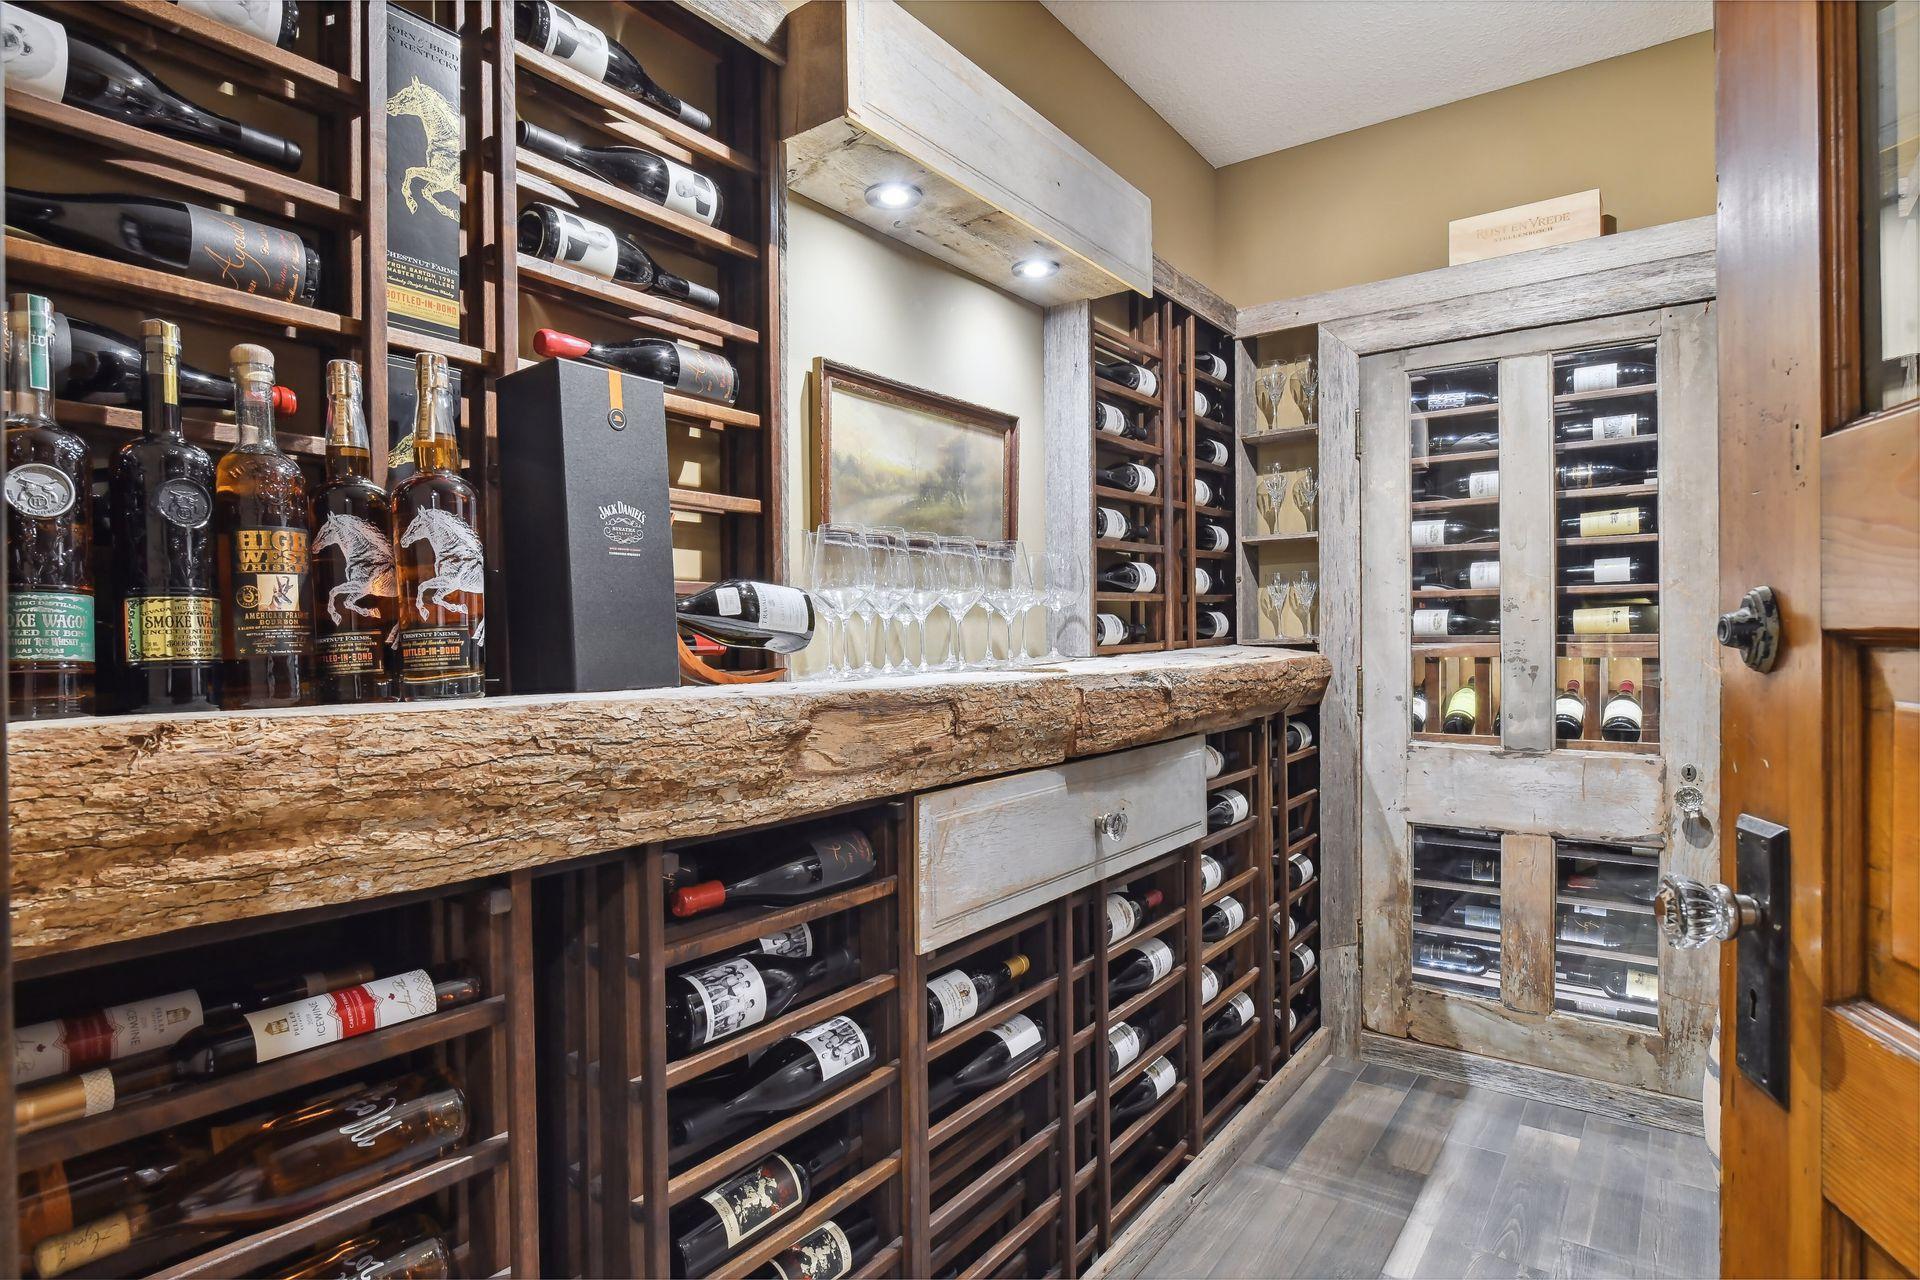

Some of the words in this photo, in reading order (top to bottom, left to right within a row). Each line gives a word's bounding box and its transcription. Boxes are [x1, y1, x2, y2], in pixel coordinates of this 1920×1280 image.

[400, 40, 459, 72] KENTUCKY
[1476, 225, 1507, 240] RUST
[1511, 222, 1527, 232] EN
[387, 249, 430, 268] CHESTNUT
[387, 261, 407, 270] FROM
[410, 267, 436, 279] BARTON
[439, 275, 455, 284] 1792
[387, 266, 415, 278] MASTER
[416, 274, 455, 290] DISTILLERS
[598, 503, 618, 520] JACK
[617, 500, 647, 525] DANIEL'S
[238, 529, 307, 551] HIGH
[238, 549, 306, 564] WEST
[144, 615, 192, 628] SMOKE
[244, 611, 284, 620] AMERICAN
[309, 1001, 326, 1037] ICEWINE
